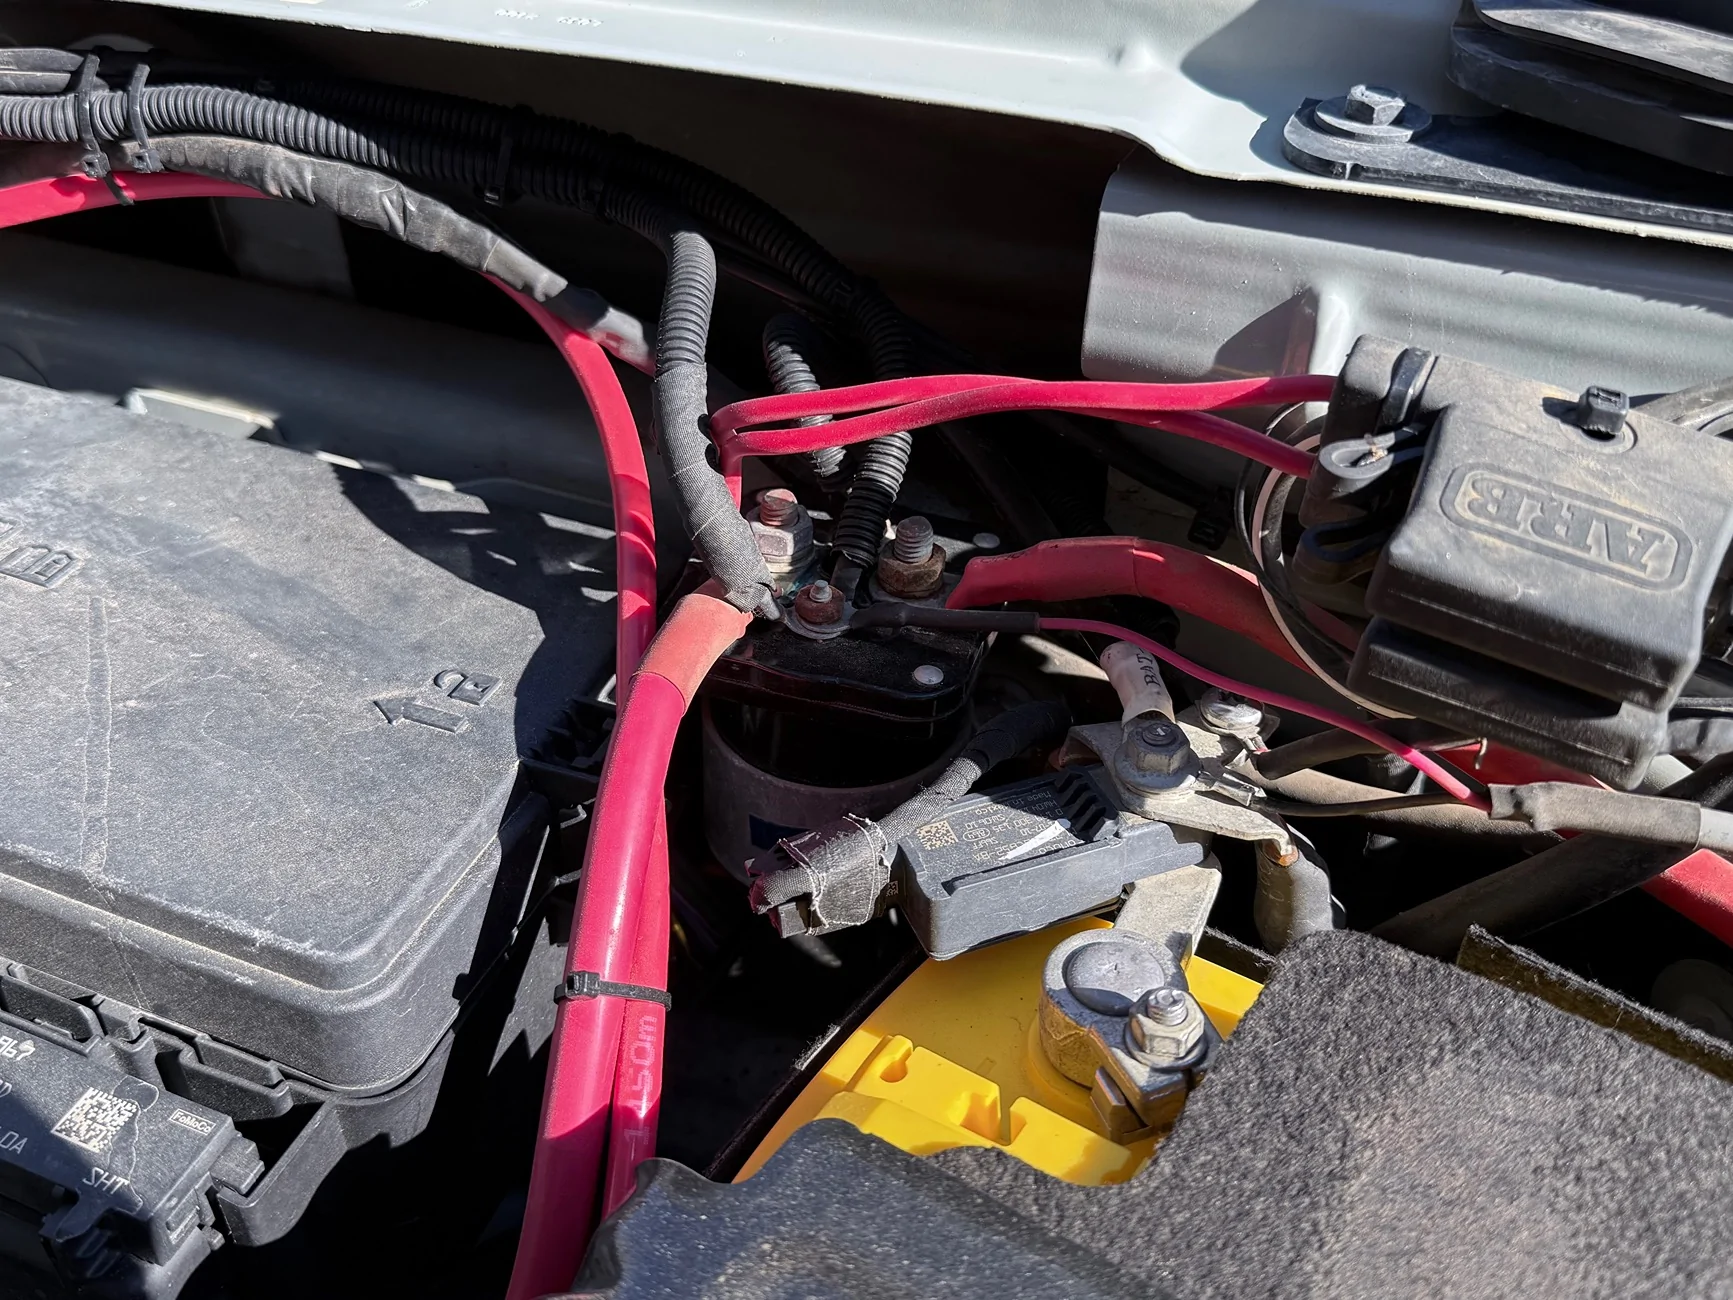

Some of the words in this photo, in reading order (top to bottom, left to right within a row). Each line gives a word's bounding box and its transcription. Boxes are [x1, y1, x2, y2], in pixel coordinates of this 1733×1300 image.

[1467, 477, 1668, 577] ARB
[1027, 791, 1051, 802] Made
[172, 1111, 212, 1133] FoMoCo
[82, 1166, 129, 1195] SHT
